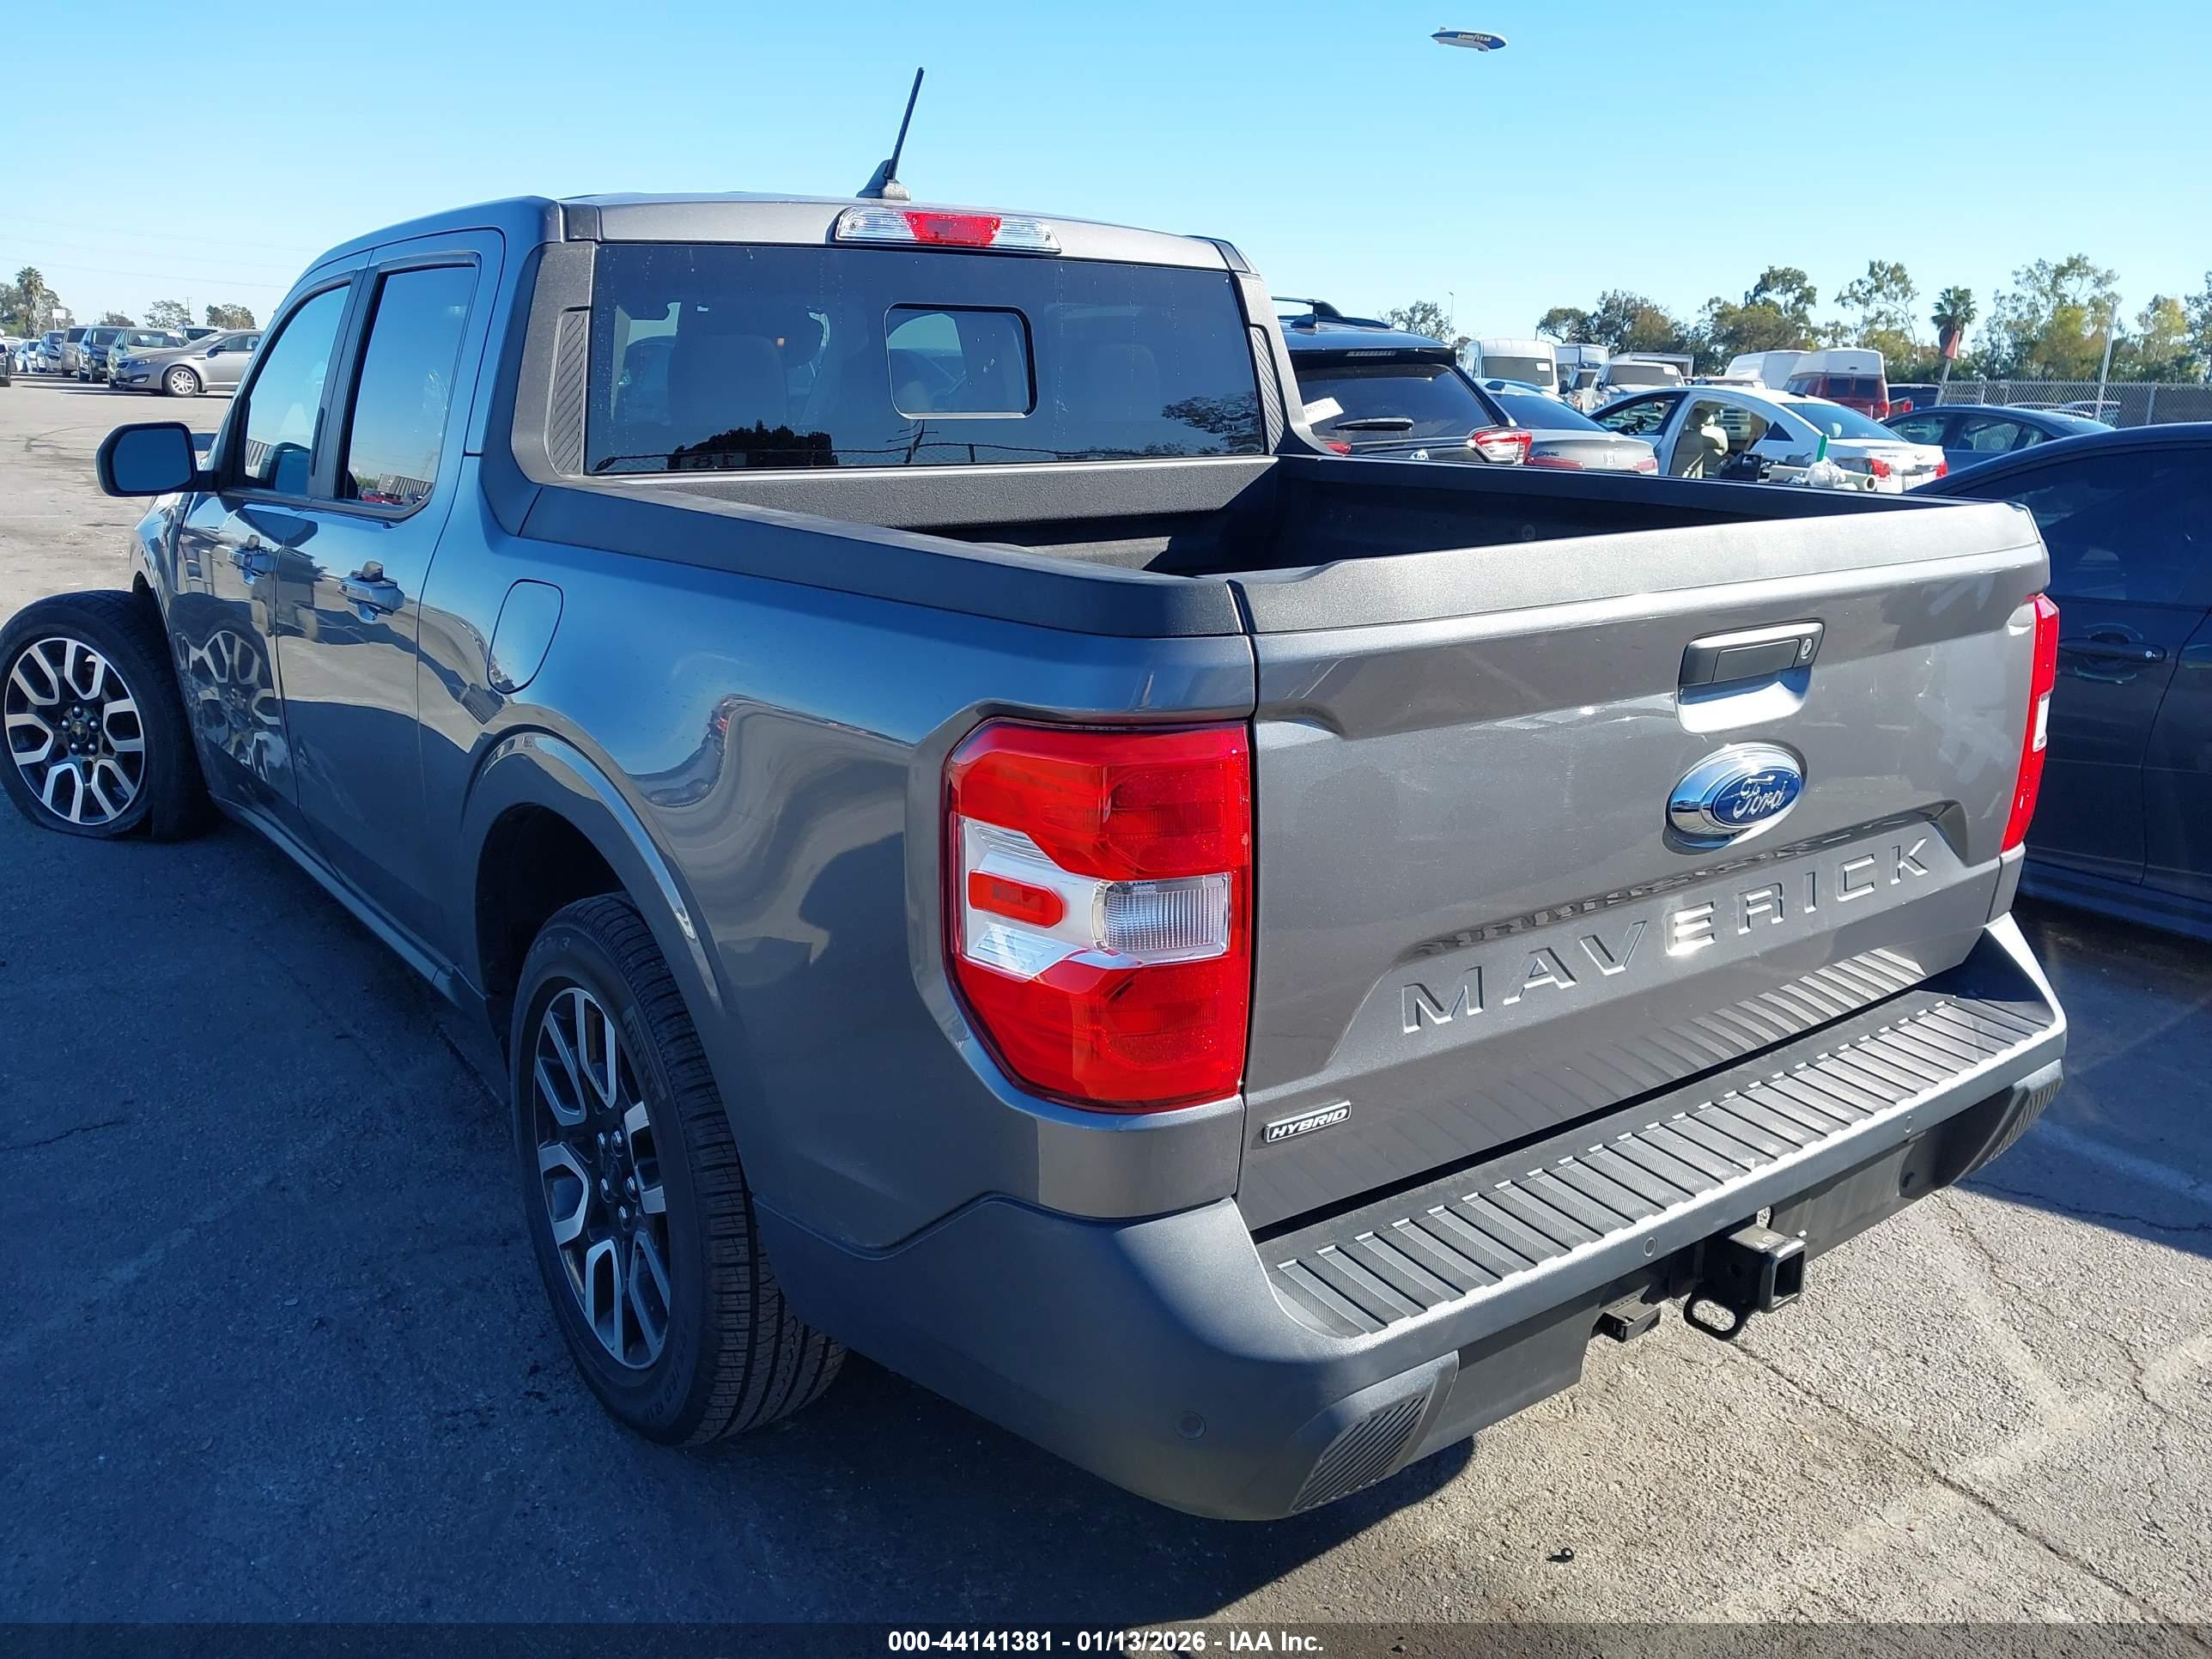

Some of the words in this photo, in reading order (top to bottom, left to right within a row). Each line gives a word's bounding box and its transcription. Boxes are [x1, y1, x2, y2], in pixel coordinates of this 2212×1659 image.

[1721, 775, 1793, 819] Ford
[1401, 836, 1929, 1034] MAVERICK
[1271, 1109, 1348, 1139] HYBRID
